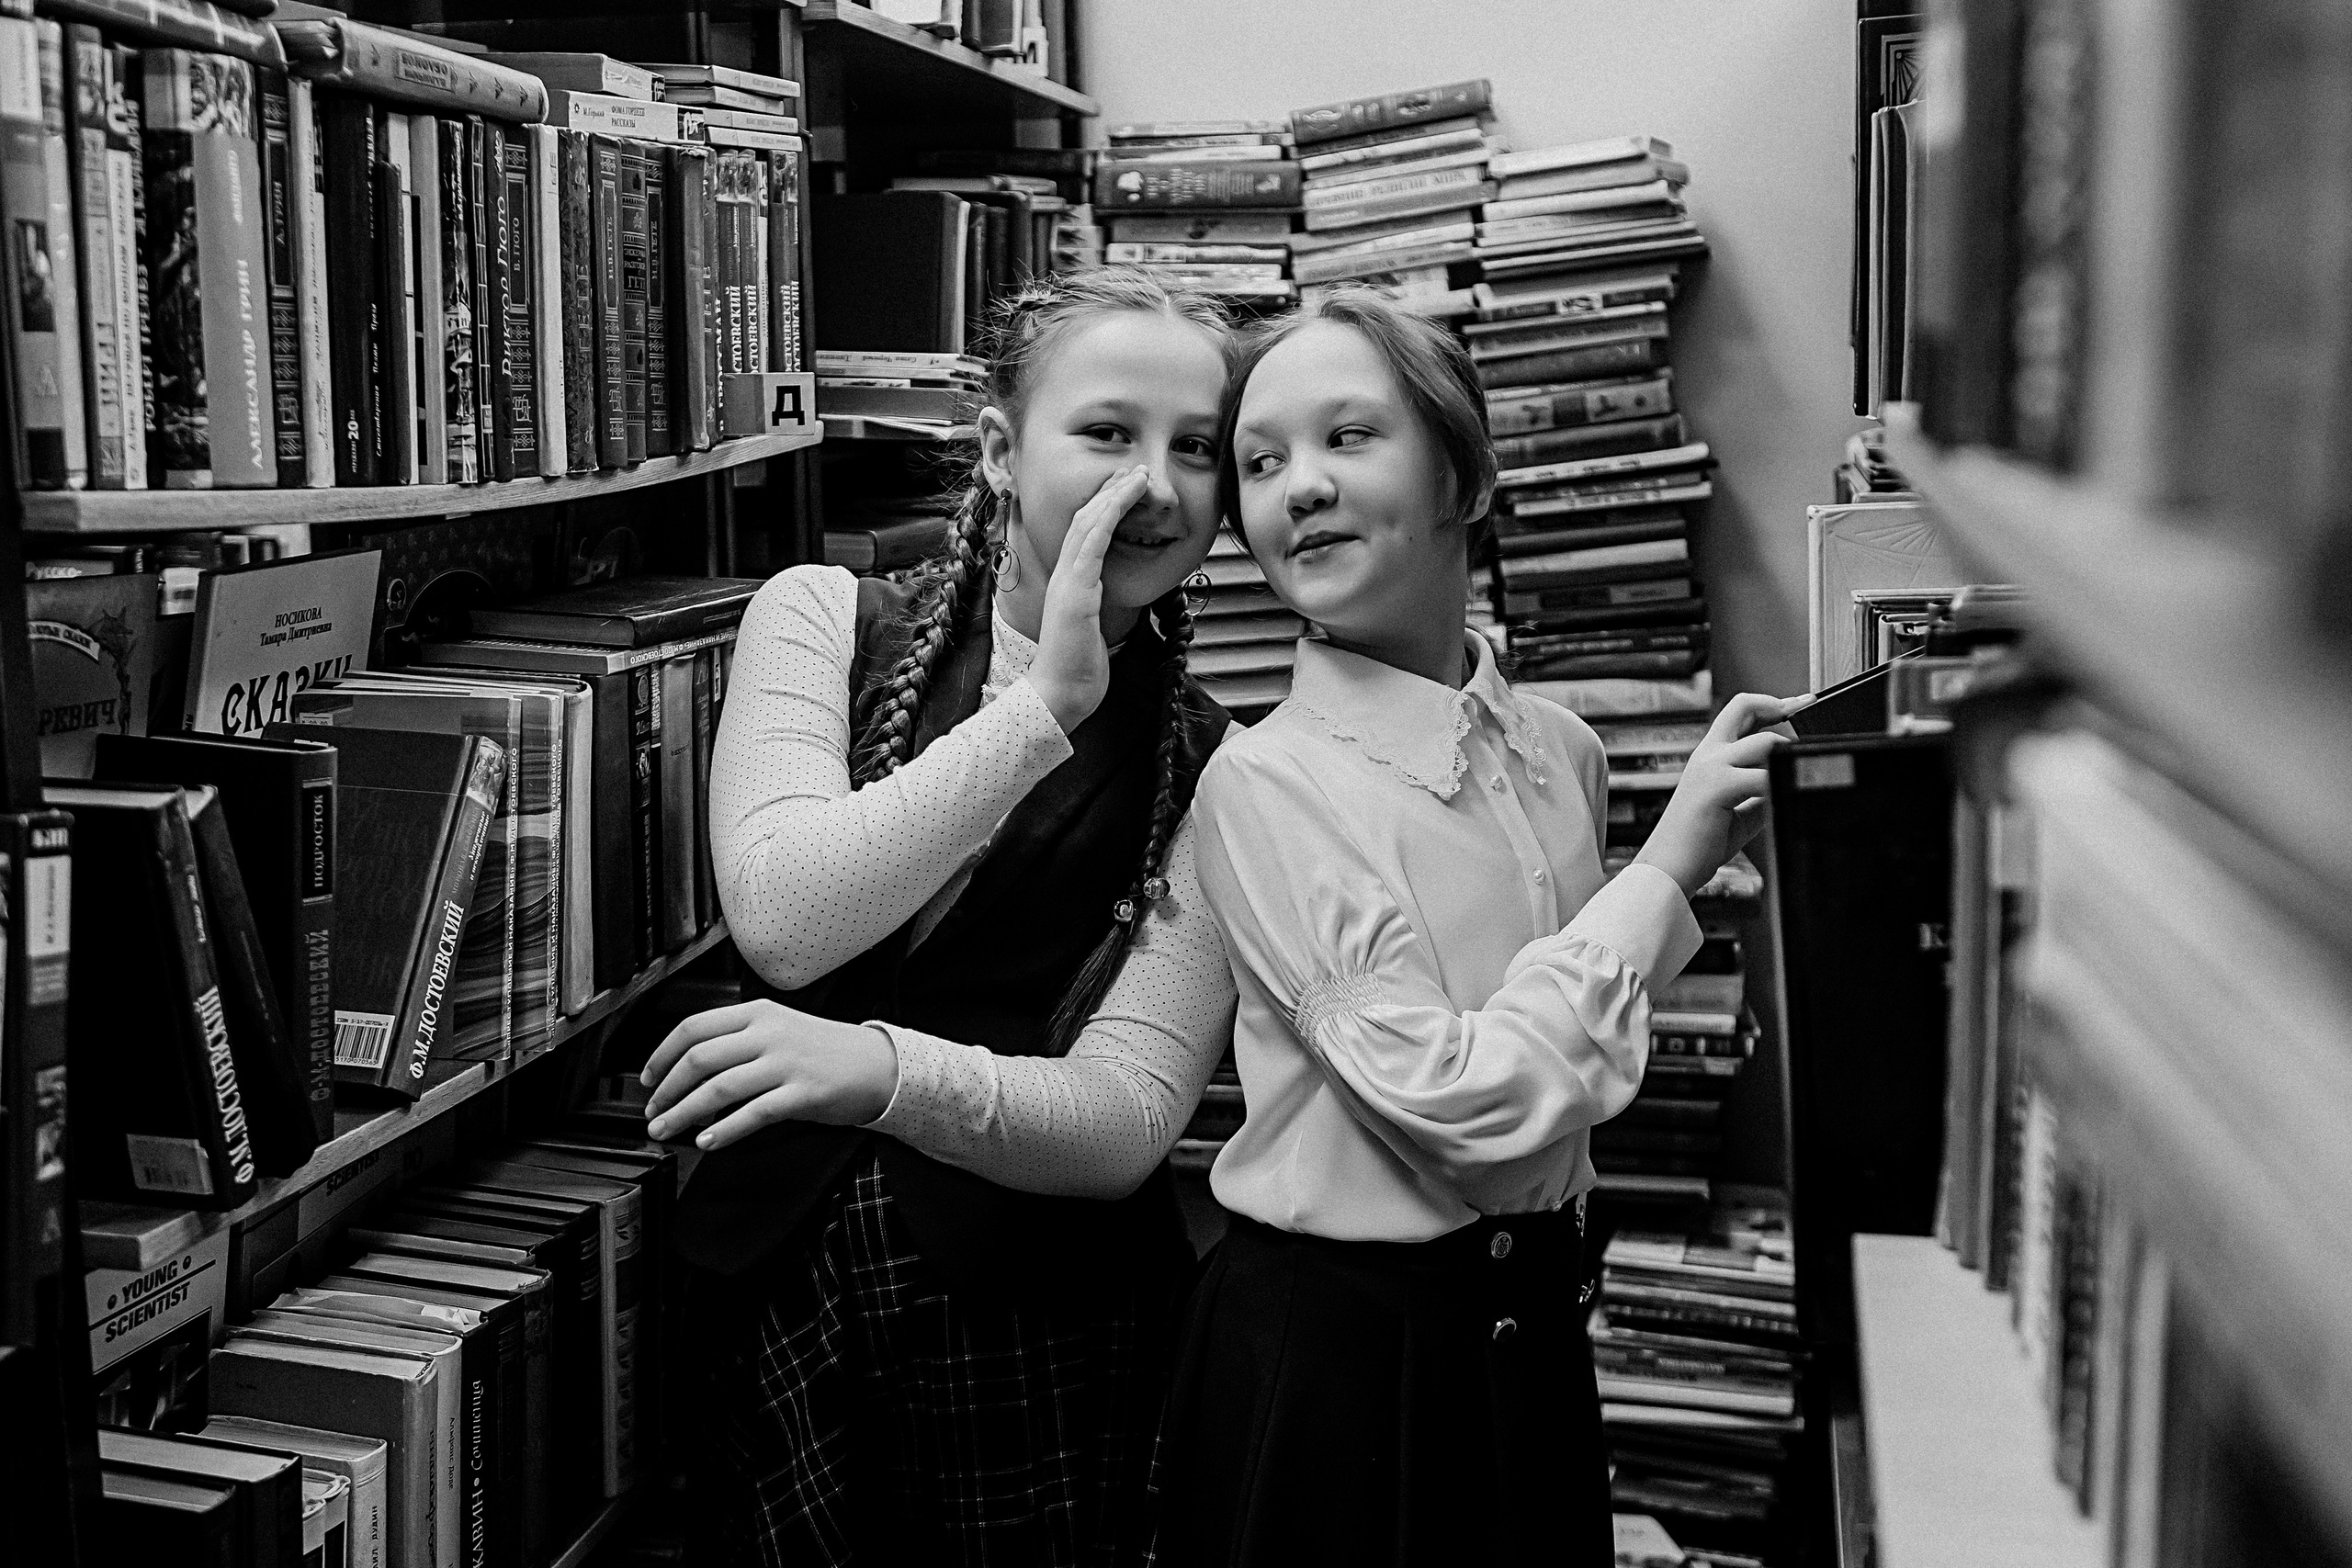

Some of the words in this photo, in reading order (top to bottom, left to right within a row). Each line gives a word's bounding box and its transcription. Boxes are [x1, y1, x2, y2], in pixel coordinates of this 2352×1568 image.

[611, 118, 636, 128] РАССКАЗЫ
[495, 196, 509, 268] ГЮГО
[512, 216, 522, 253] ГЮГО
[236, 258, 253, 322] ГРИН
[241, 329, 264, 469] АЛЕКСАНДР
[771, 384, 806, 428] Д
[260, 632, 288, 647] Тамара
[288, 622, 333, 643] Дмитриевна
[275, 606, 322, 628] НОСИКОВА
[312, 793, 325, 888] ПОДРОСТОК
[121, 1259, 178, 1304] YOUNG
[105, 1281, 191, 1343] SCIENTIST
